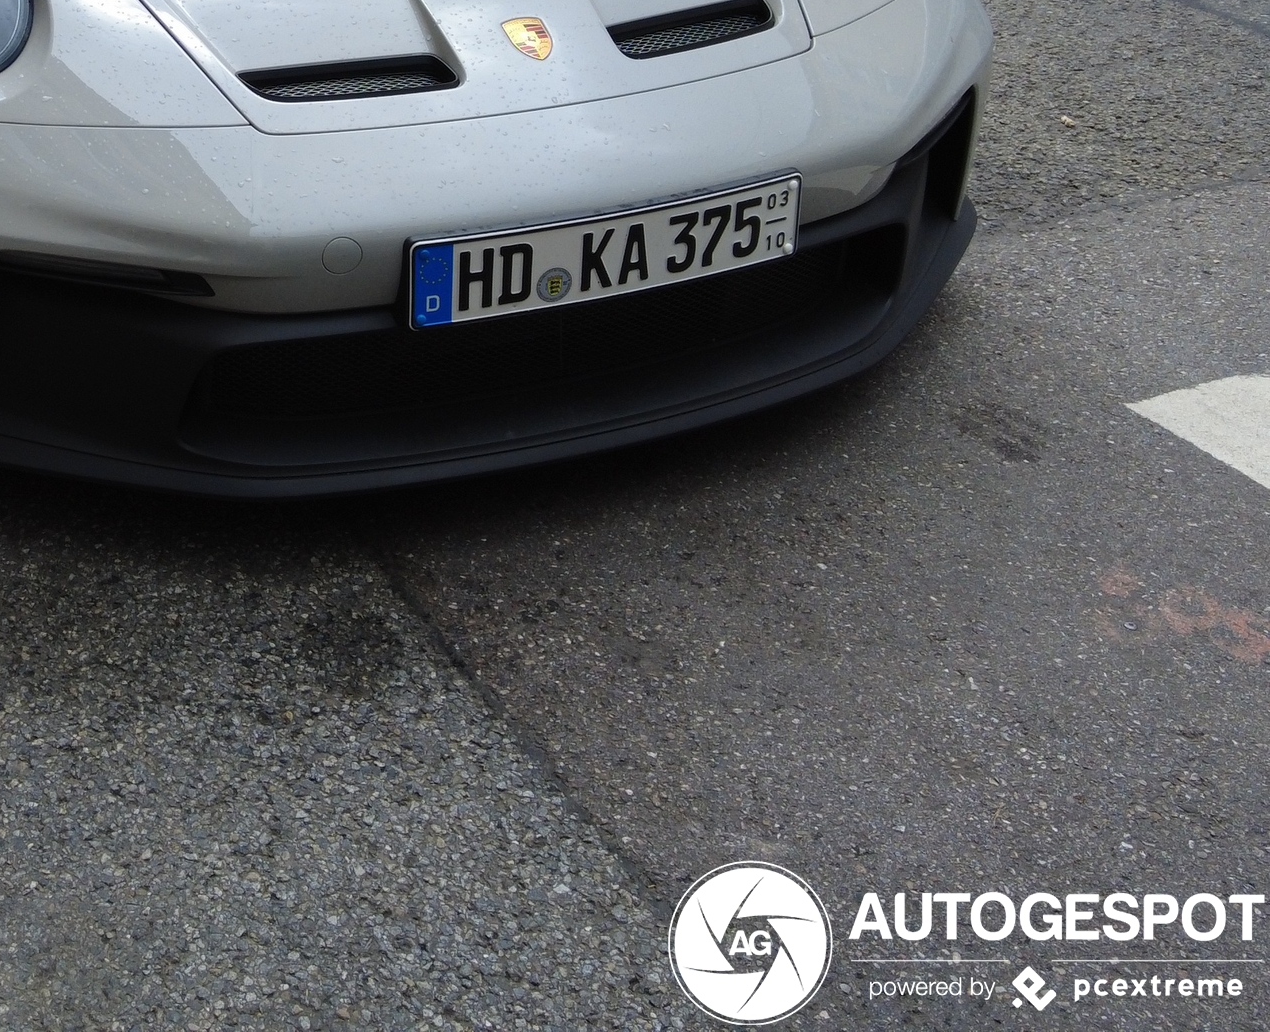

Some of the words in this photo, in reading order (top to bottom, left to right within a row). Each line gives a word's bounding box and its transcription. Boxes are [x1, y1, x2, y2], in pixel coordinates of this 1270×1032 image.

[767, 190, 789, 210] 03
[765, 231, 786, 251] 10
[458, 243, 534, 312] HD
[580, 223, 649, 292] KA
[666, 196, 763, 273] 375
[426, 295, 440, 313] D
